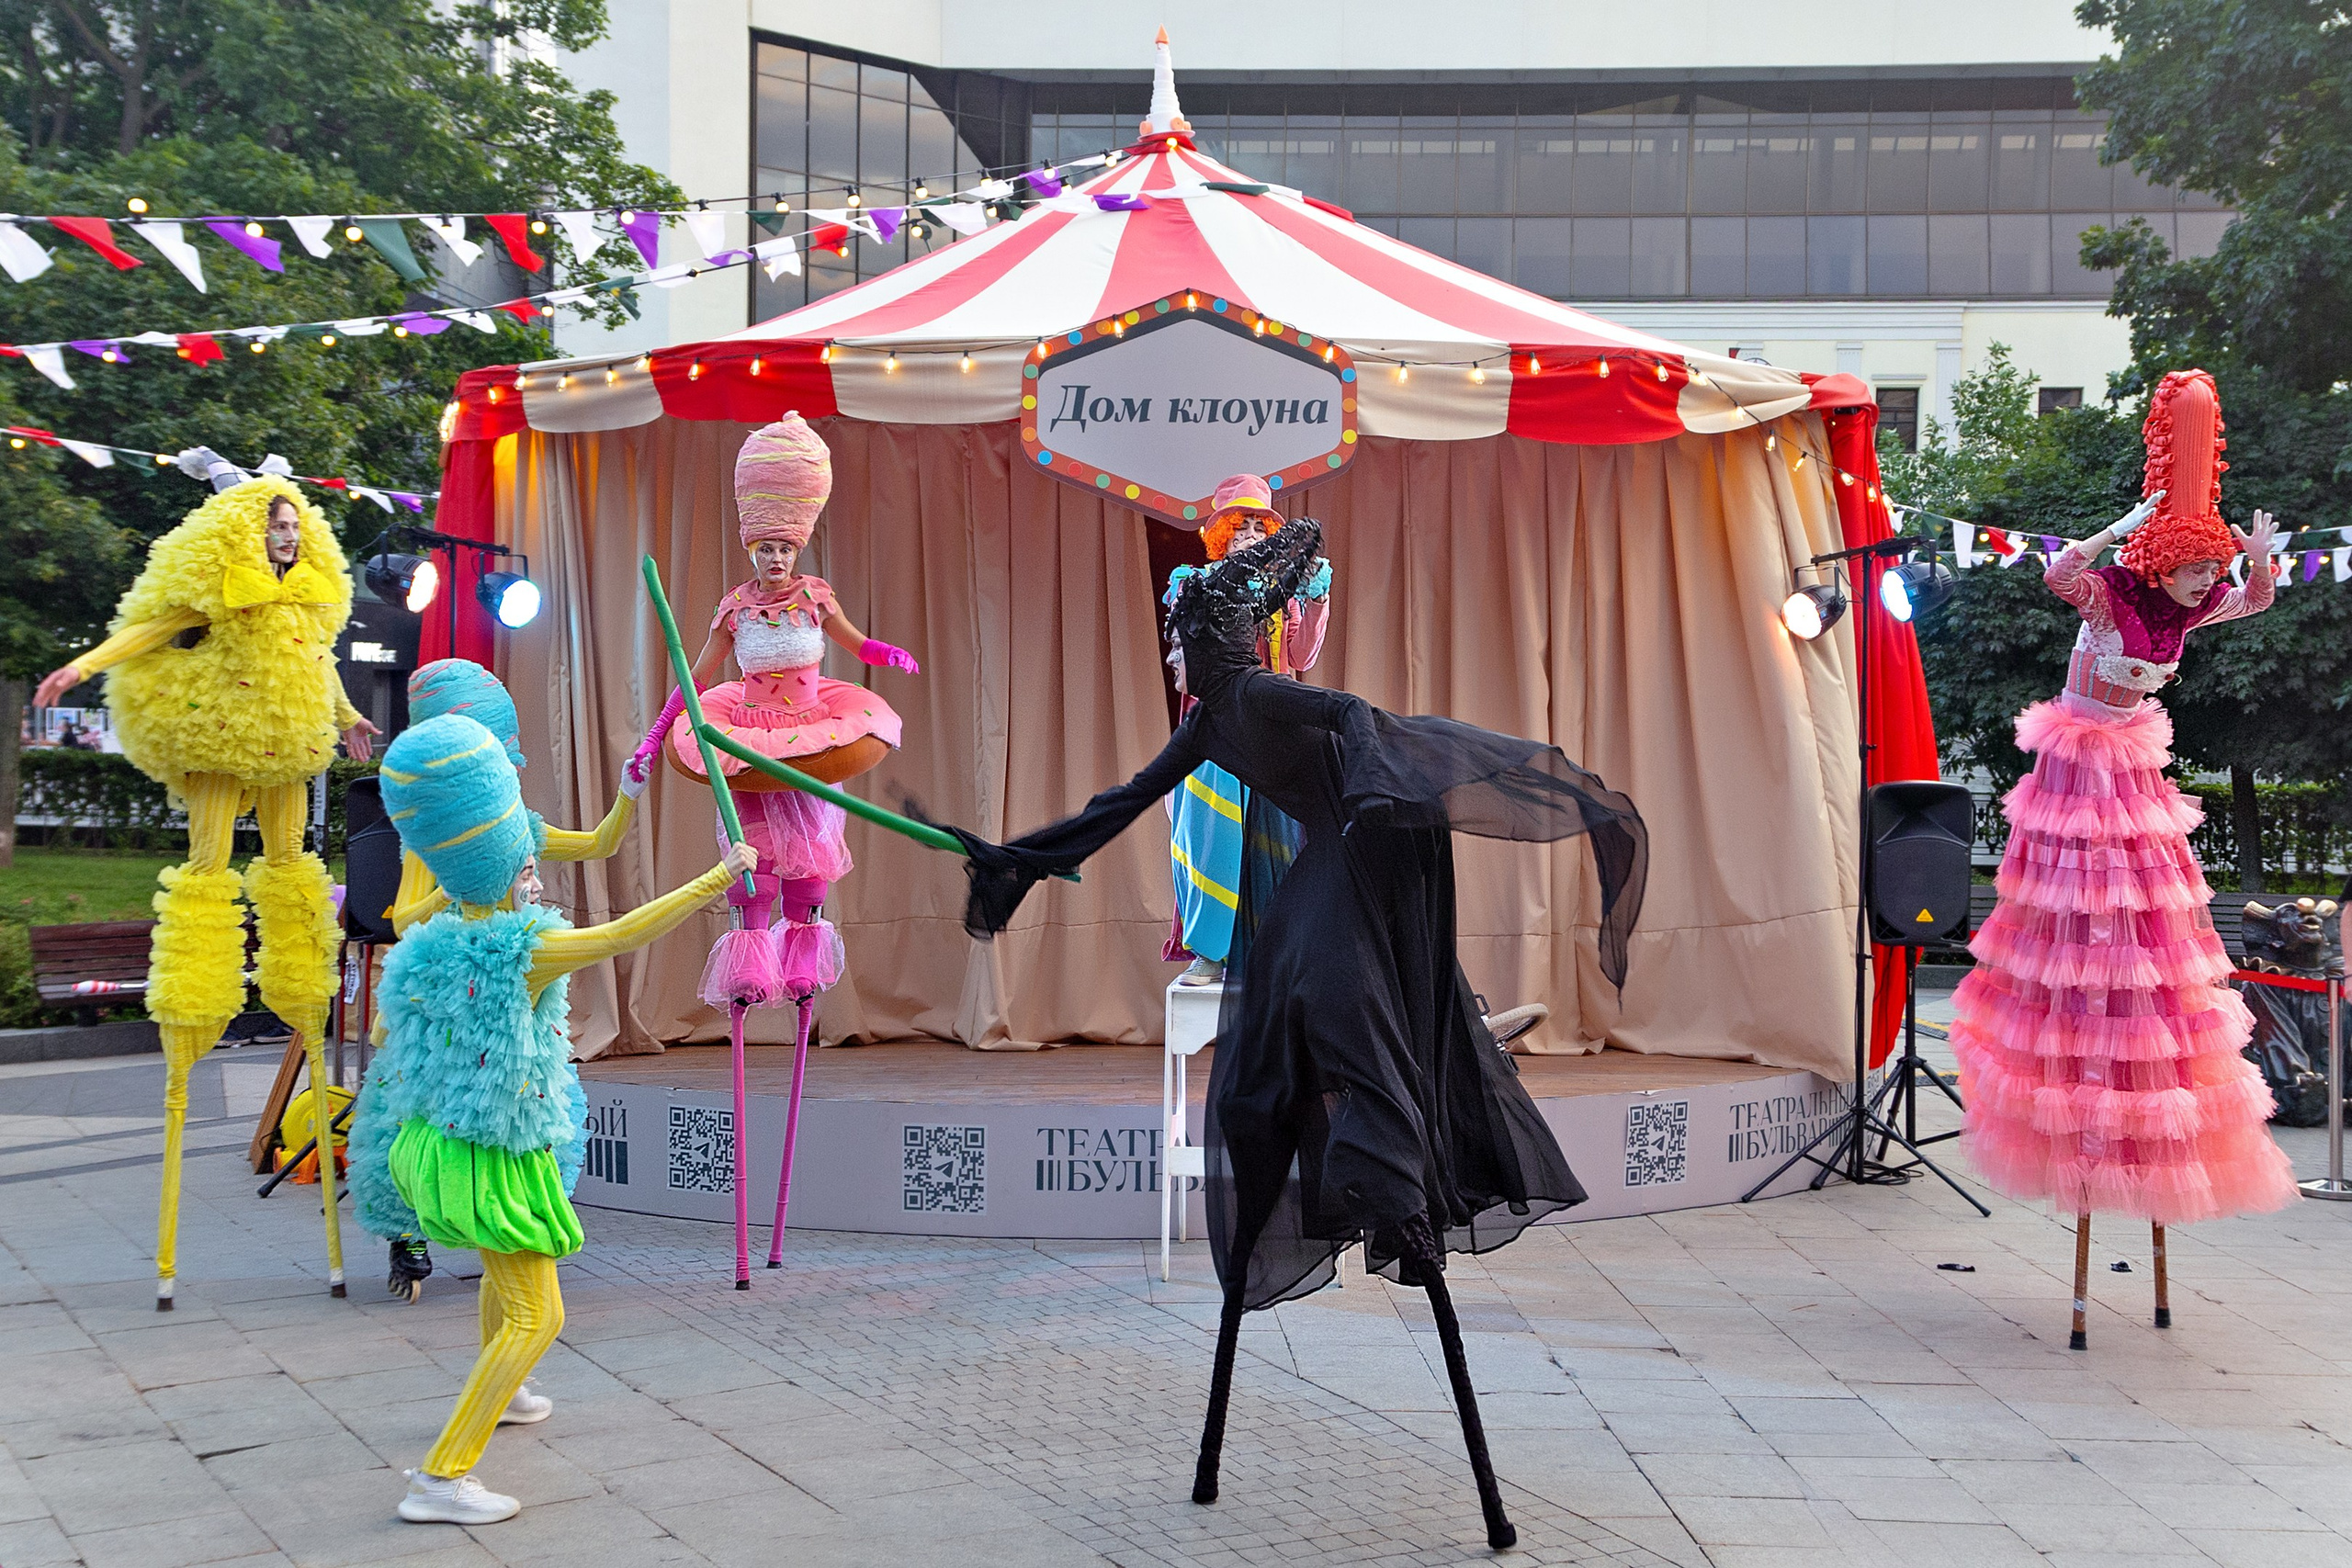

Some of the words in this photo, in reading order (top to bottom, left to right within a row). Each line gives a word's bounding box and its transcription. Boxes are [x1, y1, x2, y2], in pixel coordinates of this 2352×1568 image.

[1049, 384, 1152, 434] Дом
[1168, 397, 1329, 437] клоуна
[1036, 1128, 1193, 1157] ТЕАТР
[1067, 1159, 1205, 1193] БУЛЬ
